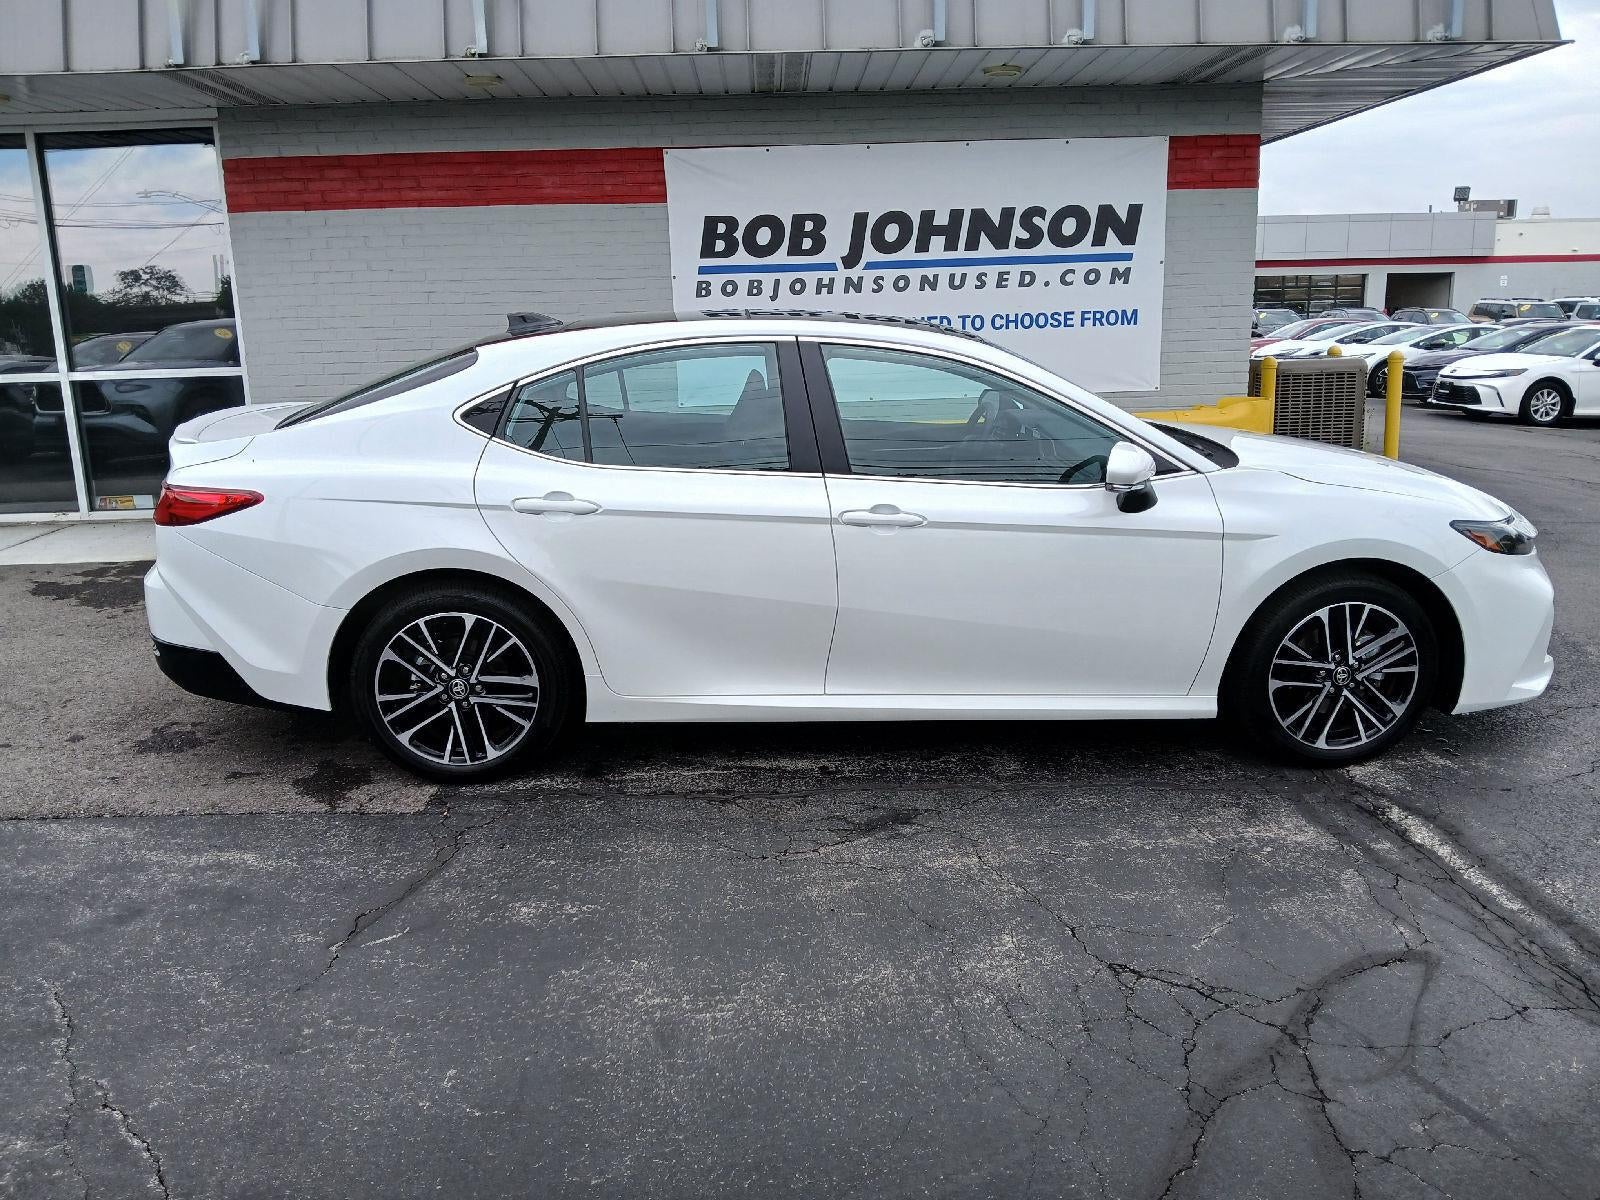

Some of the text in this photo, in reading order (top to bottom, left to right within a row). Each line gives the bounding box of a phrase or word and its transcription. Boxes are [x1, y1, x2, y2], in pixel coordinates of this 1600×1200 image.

[699, 203, 1144, 270] BOB JOHNSON
[695, 267, 1132, 301] BOBJOHNSONUSED.COM
[957, 315, 985, 332] TO
[990, 311, 1075, 331] CHOOSE
[1080, 309, 1139, 328] FROM
